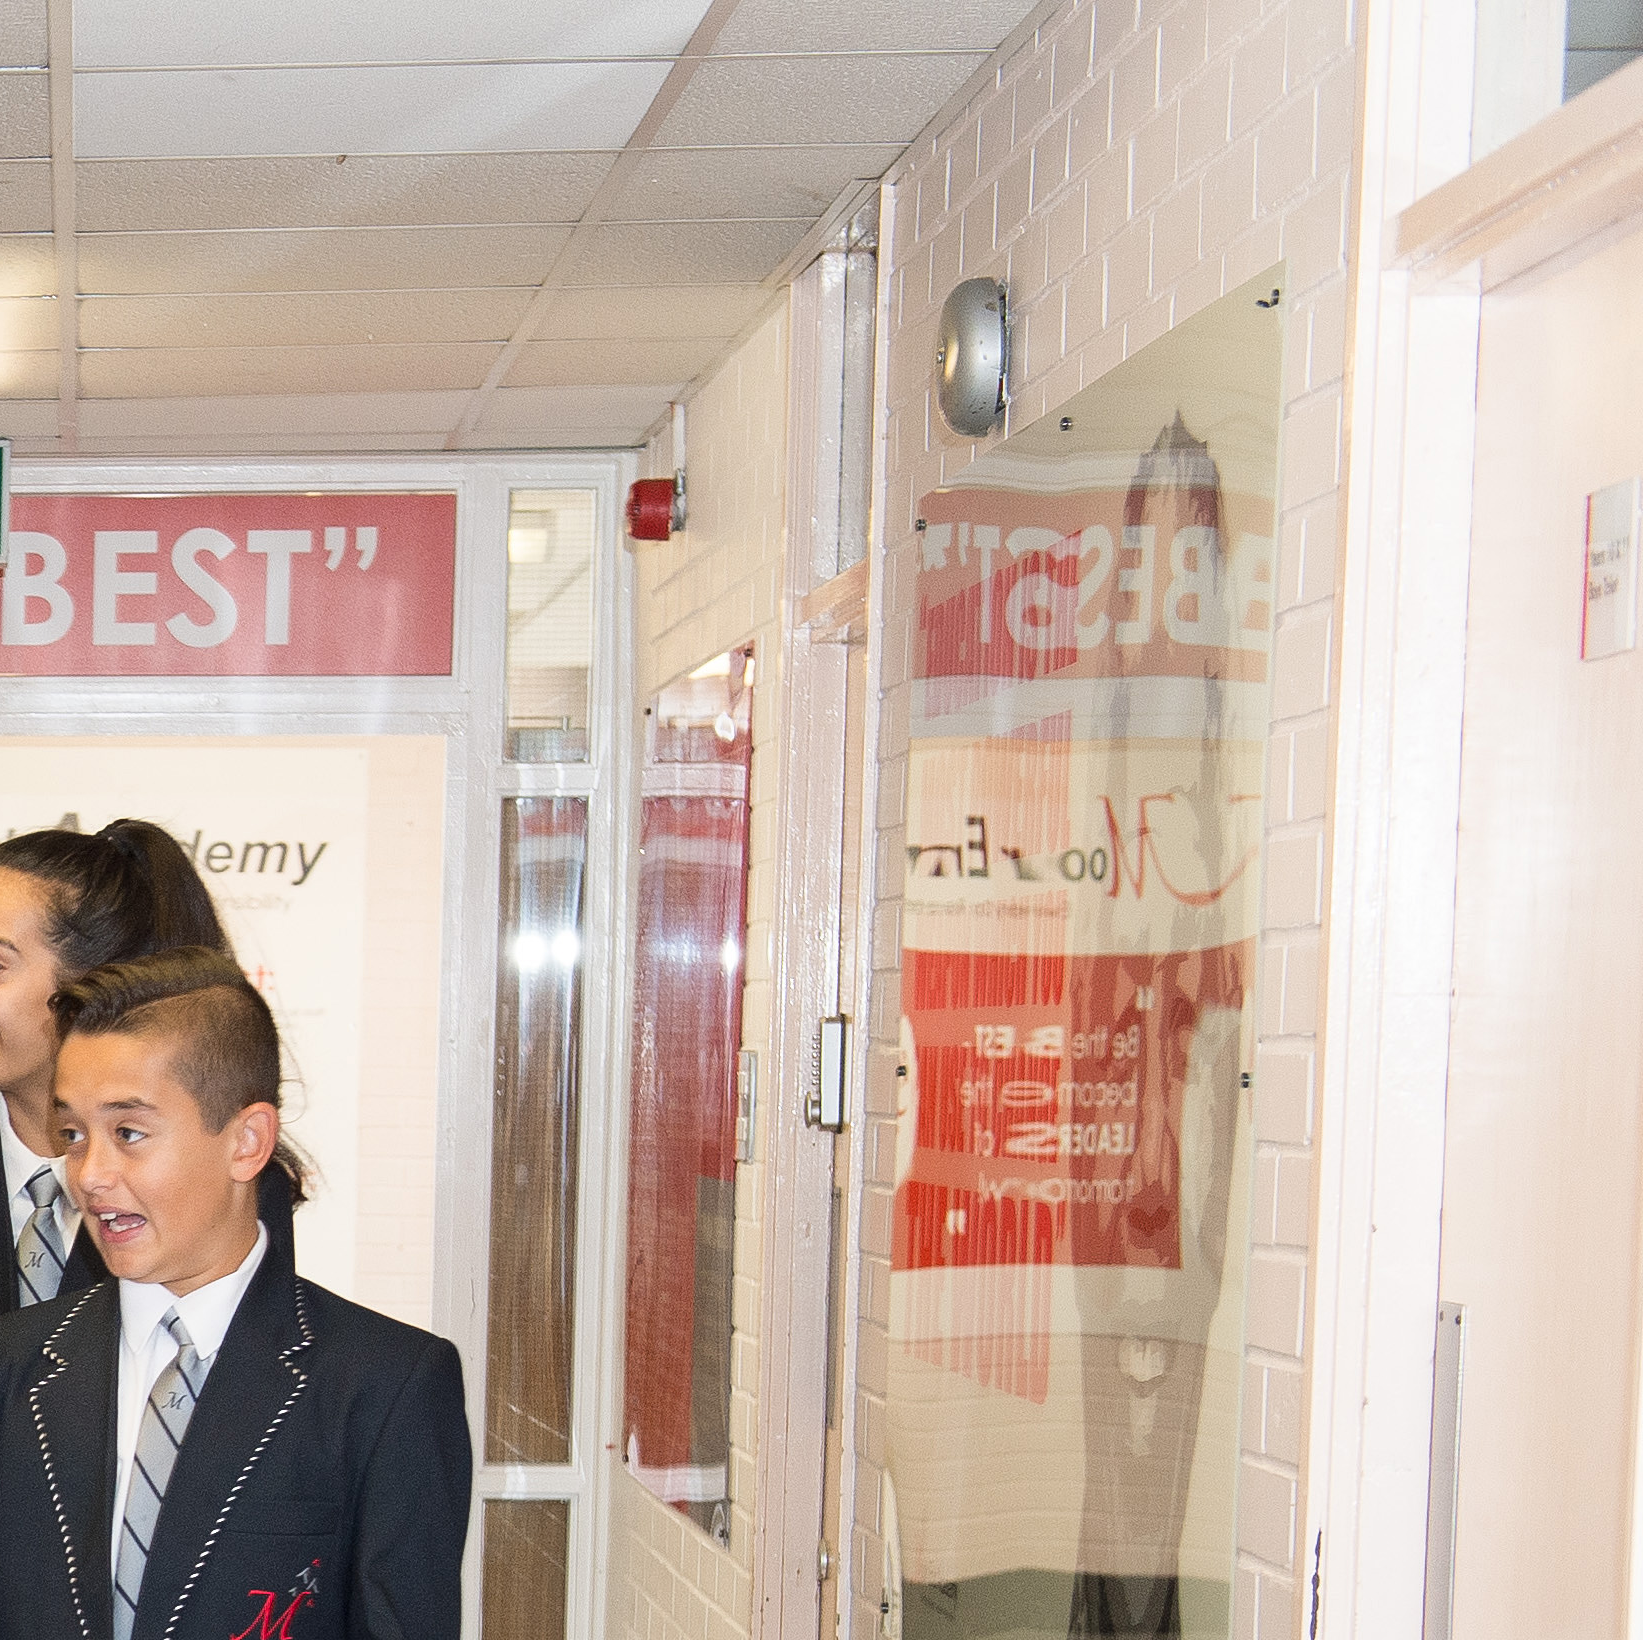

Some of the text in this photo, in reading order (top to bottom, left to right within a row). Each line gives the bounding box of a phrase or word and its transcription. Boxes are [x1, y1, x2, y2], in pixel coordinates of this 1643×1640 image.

[2, 527, 380, 648] BEST”
[24, 1252, 45, 1268] M
[161, 1390, 186, 1410] M
